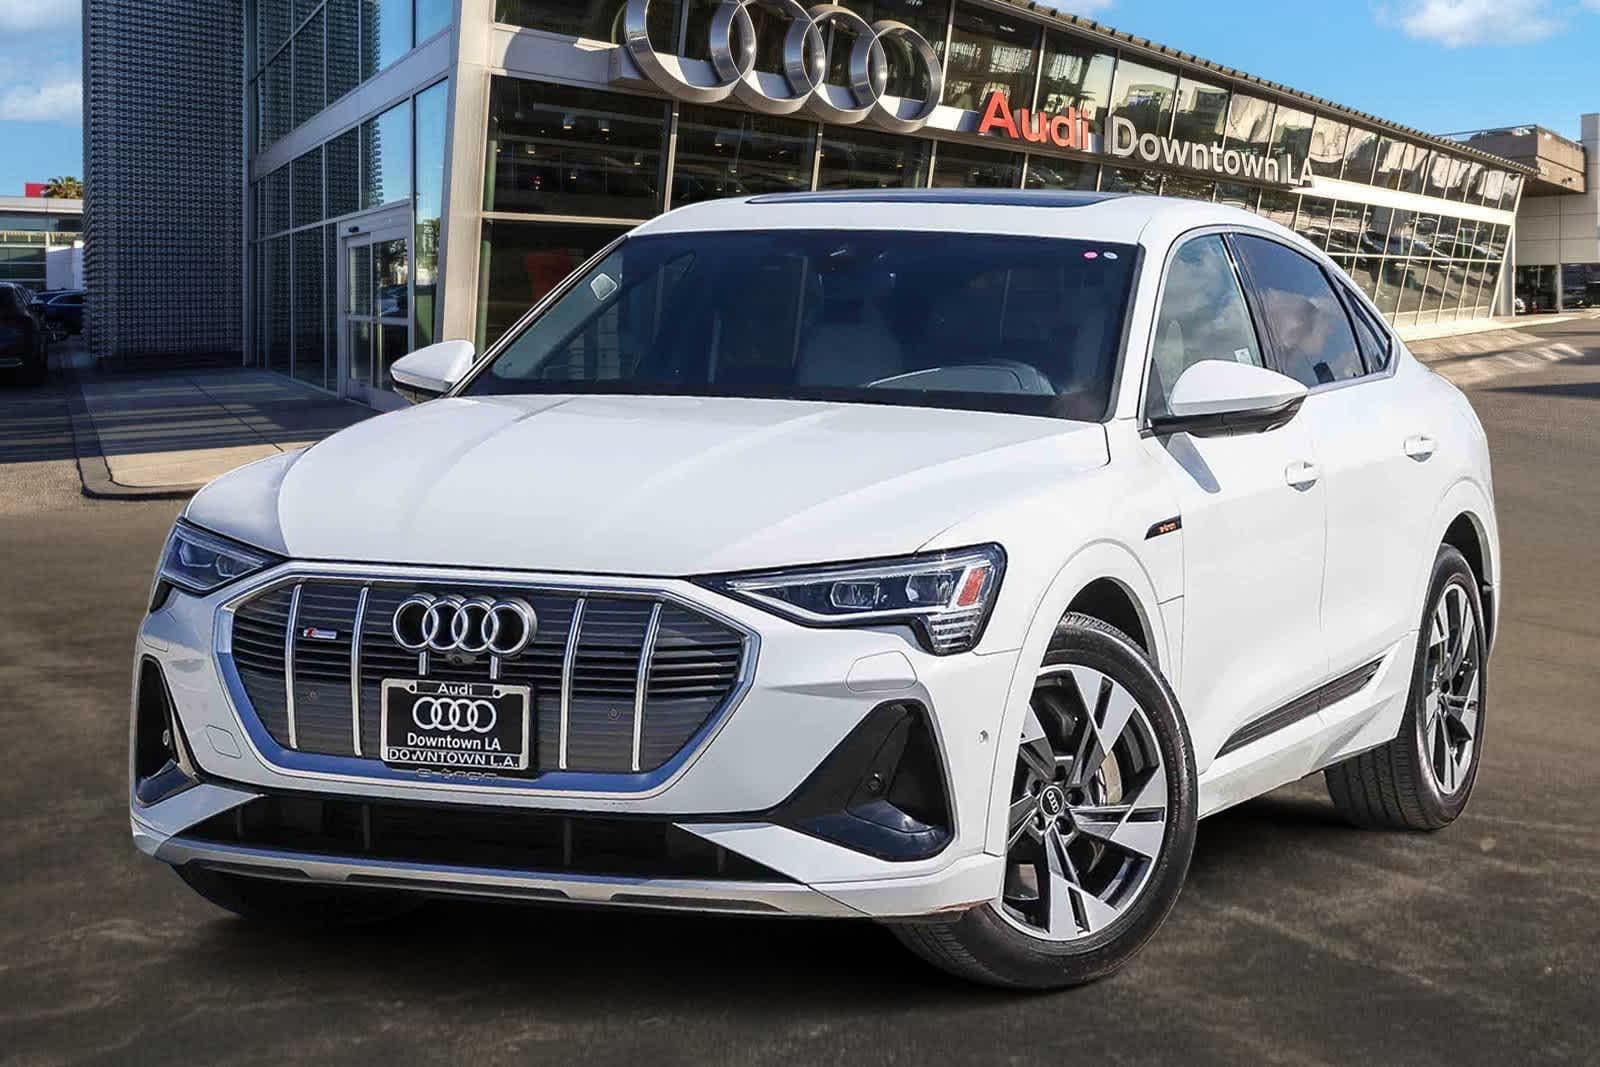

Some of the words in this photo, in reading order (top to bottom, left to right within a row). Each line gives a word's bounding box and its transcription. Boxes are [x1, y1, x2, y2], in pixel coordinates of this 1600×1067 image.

[978, 90, 1089, 151] Audi
[1104, 115, 1280, 182] Downtown
[1281, 152, 1316, 188] LA
[437, 683, 473, 696] Audi
[407, 732, 481, 750] Downtown
[484, 737, 501, 751] LA
[389, 749, 486, 765] DOWNTOWN
[490, 757, 519, 768] L.A.
